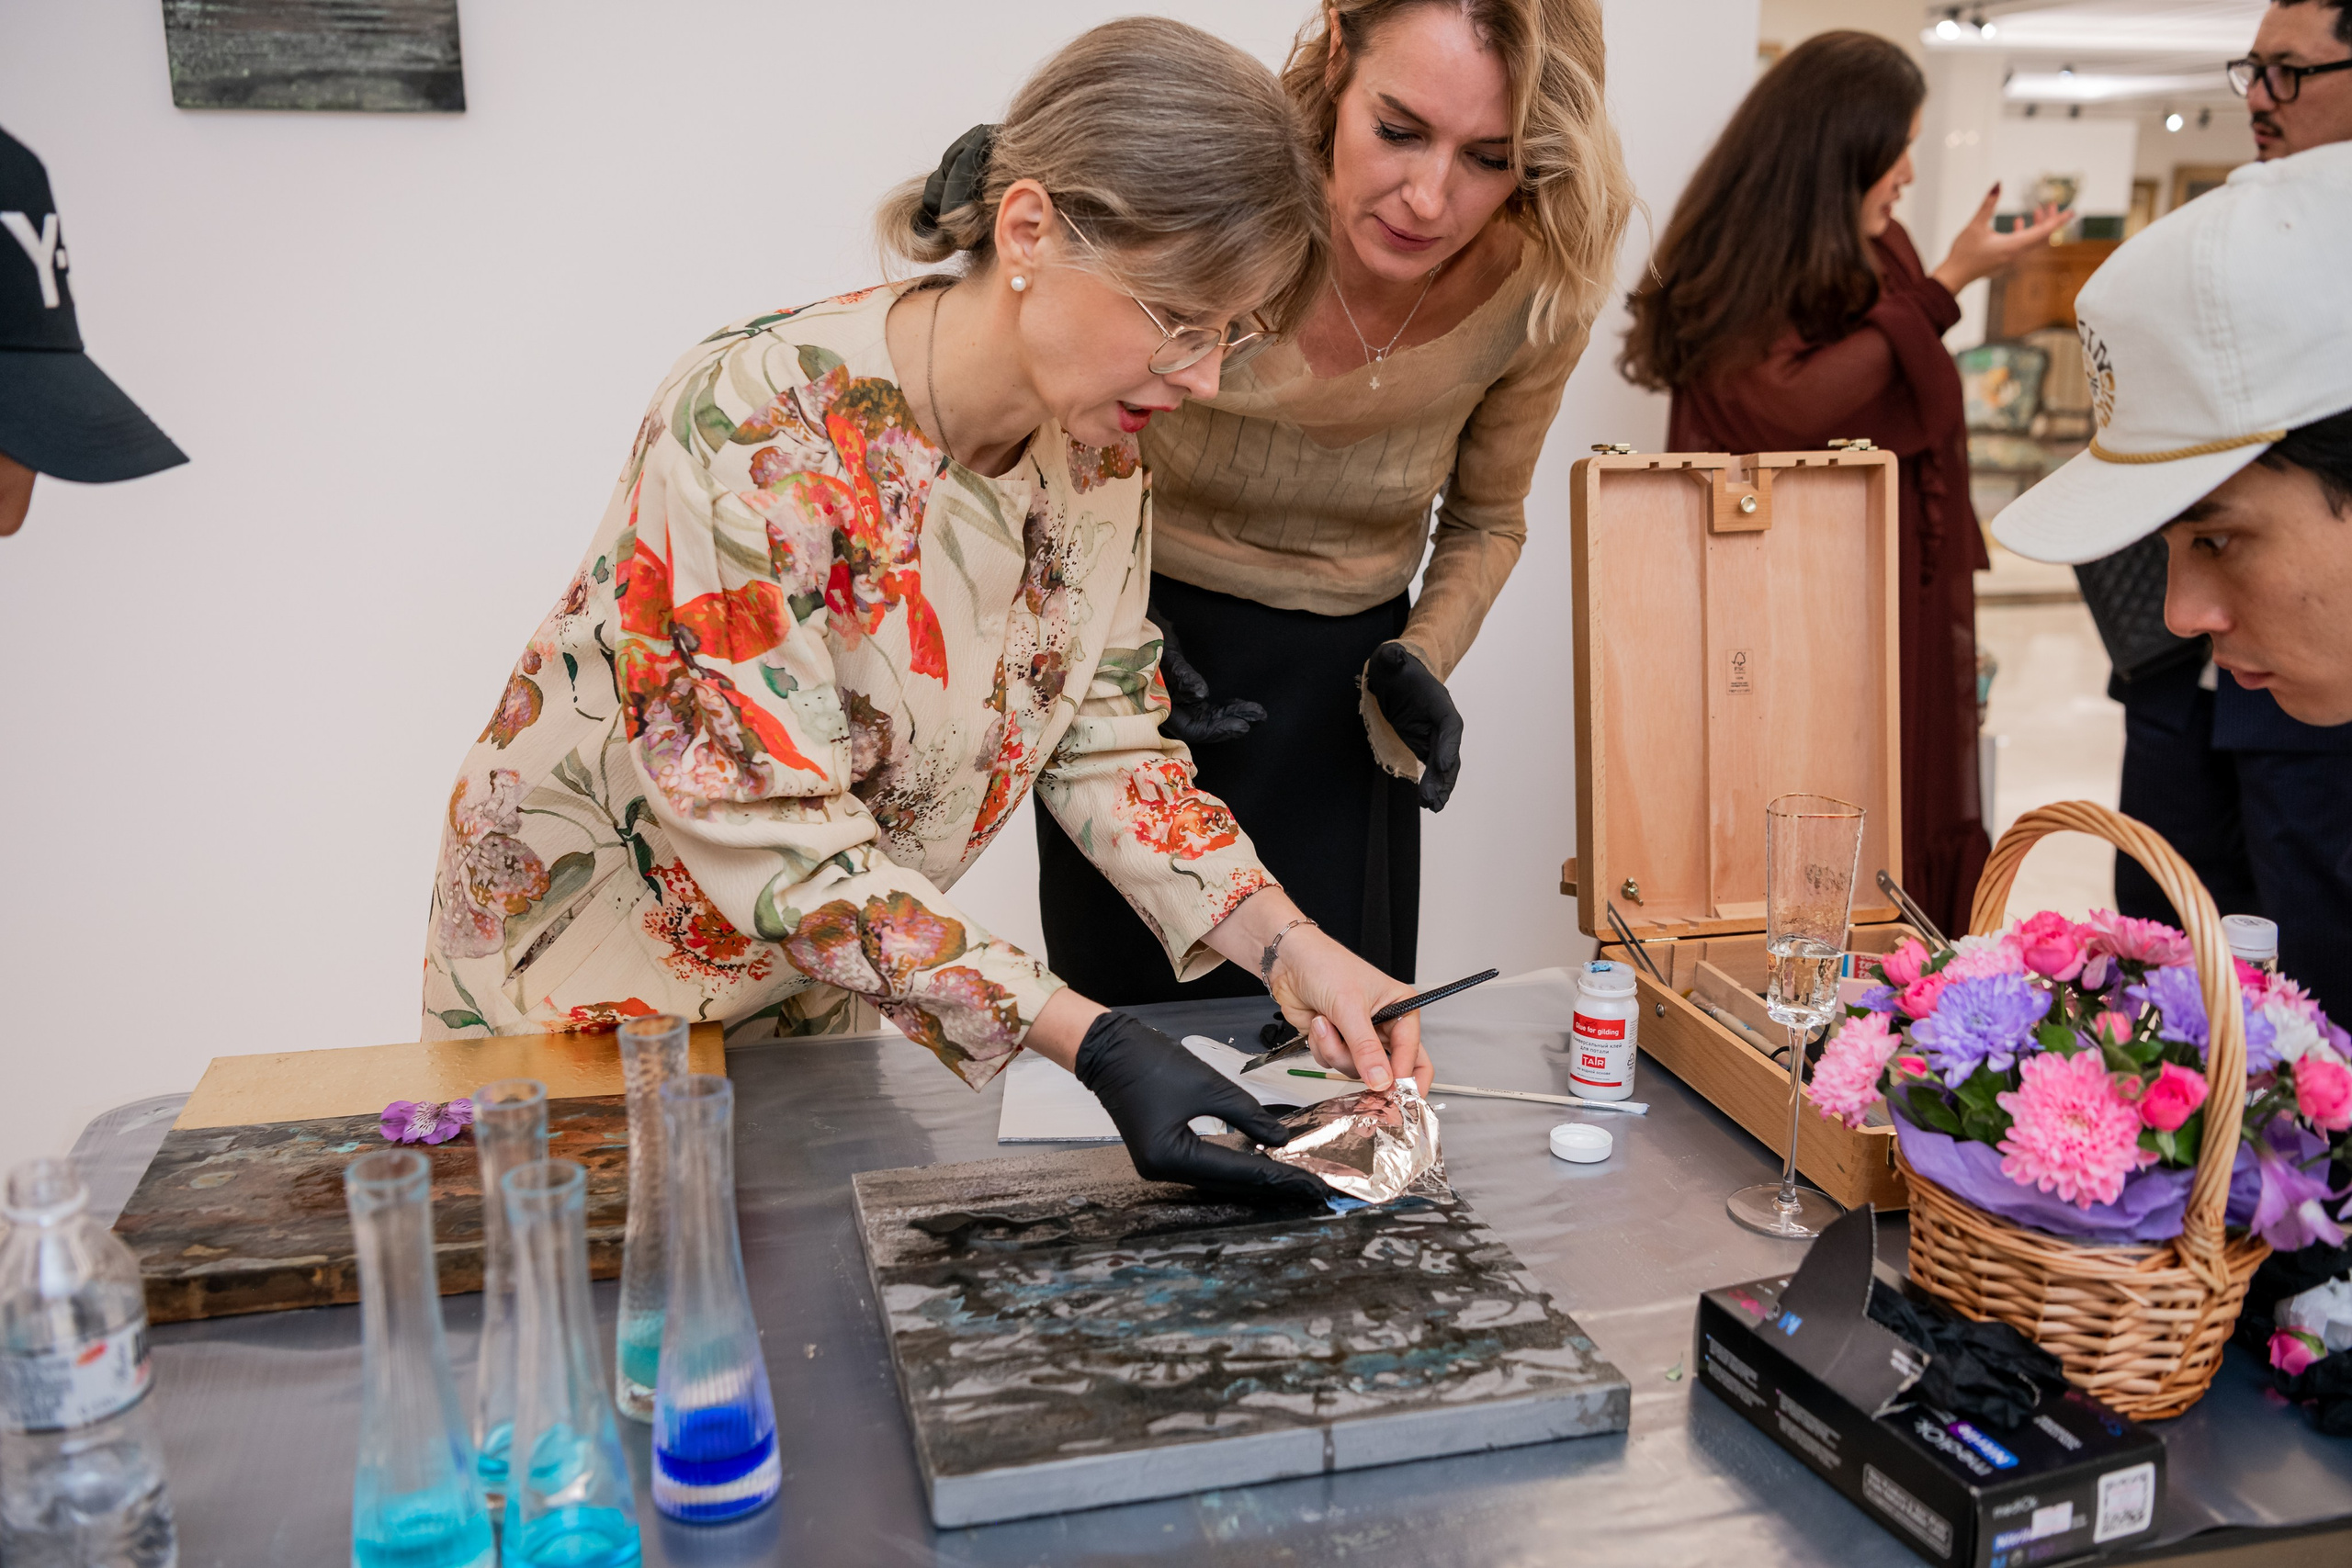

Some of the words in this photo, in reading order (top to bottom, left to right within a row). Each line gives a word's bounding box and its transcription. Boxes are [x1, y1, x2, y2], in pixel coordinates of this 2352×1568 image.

[1575, 1021, 1587, 1032] Glue
[1587, 1025, 1597, 1033] for
[1597, 1028, 1620, 1037] gilding
[1582, 1055, 1605, 1068] TAIR
